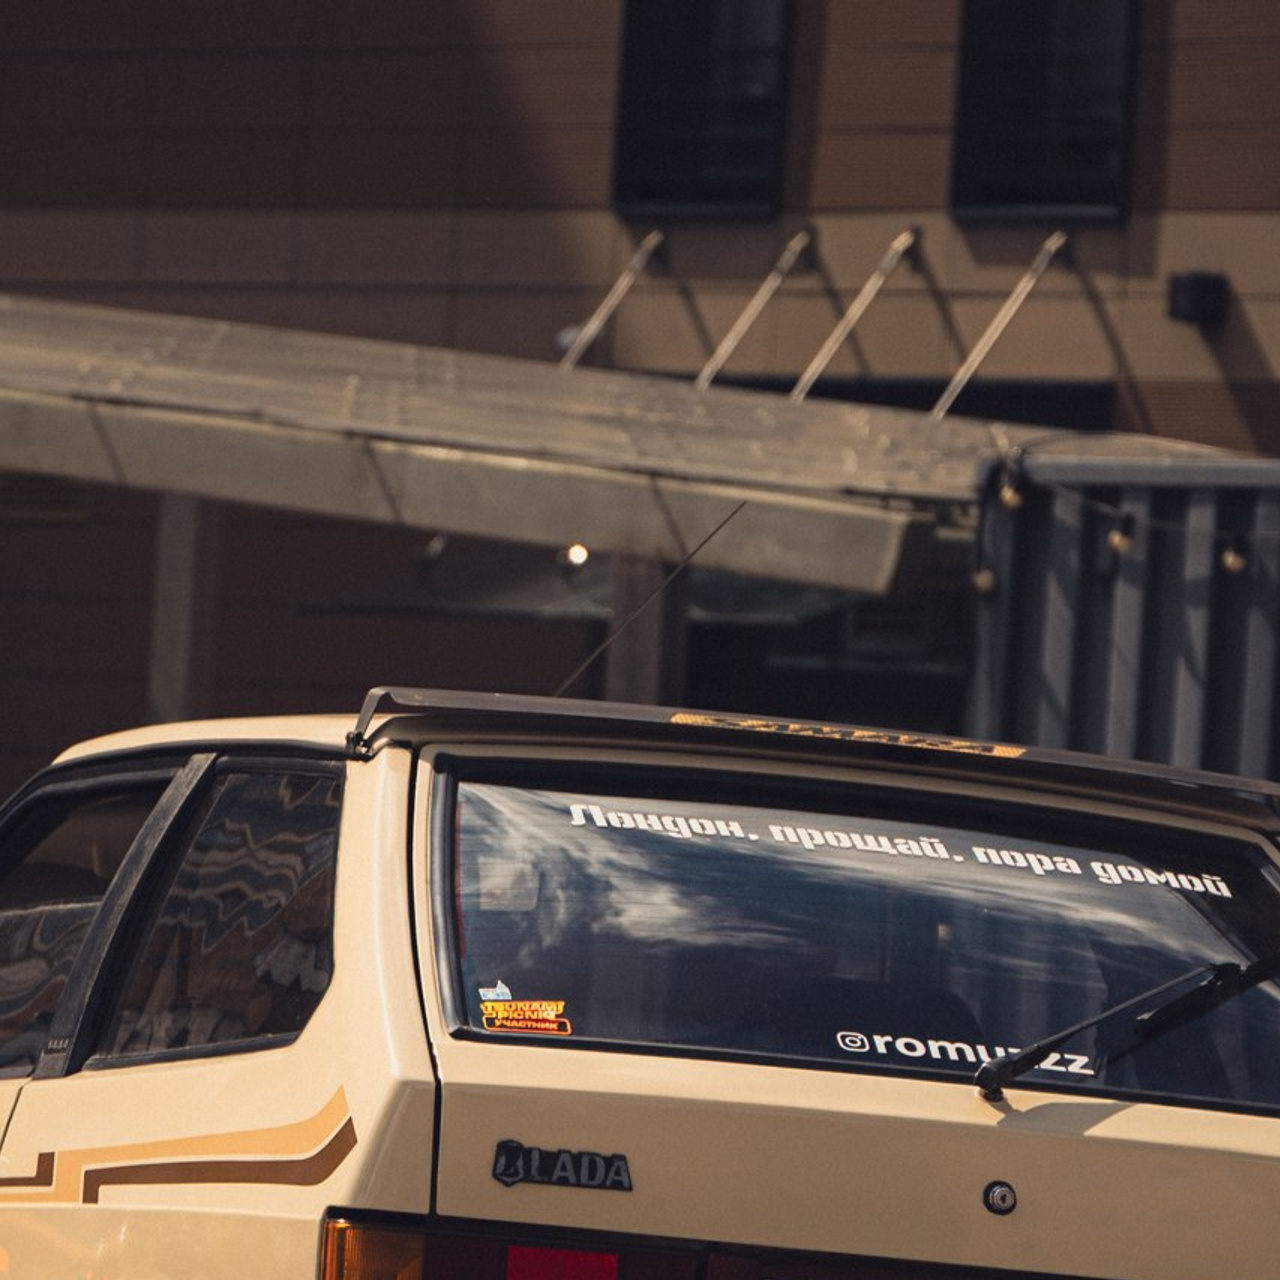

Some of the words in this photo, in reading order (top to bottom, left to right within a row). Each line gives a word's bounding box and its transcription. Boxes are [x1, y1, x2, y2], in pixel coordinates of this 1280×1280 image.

[972, 846, 1082, 875] пора
[1089, 860, 1233, 898] домой
[529, 1148, 632, 1190] LADA
